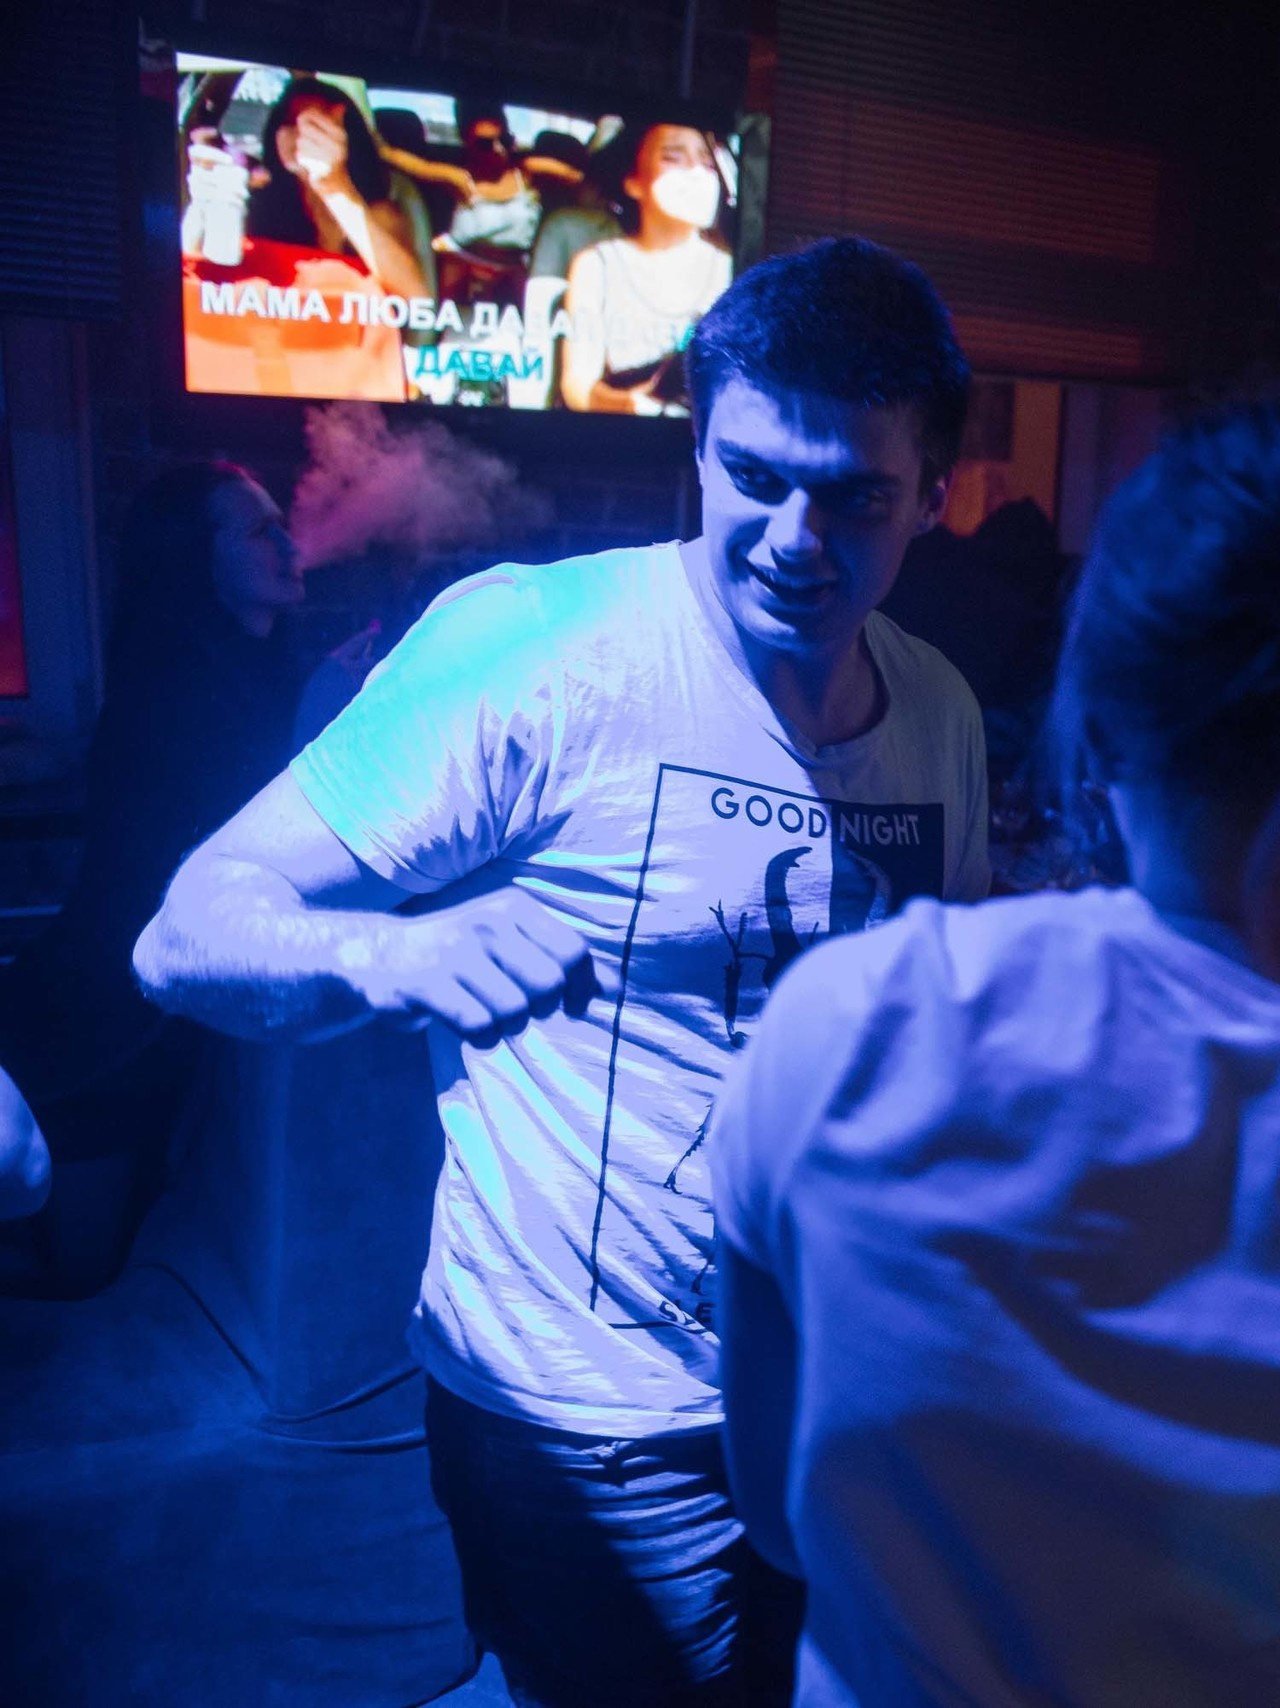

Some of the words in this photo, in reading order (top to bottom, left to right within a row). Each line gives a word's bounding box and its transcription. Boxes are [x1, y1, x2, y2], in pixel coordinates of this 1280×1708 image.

[201, 281, 330, 322] МАМА
[339, 292, 464, 332] ЛЮБА
[415, 345, 543, 382] ДАВАЙ
[711, 787, 827, 839] GOOD
[839, 812, 921, 846] NIGHT
